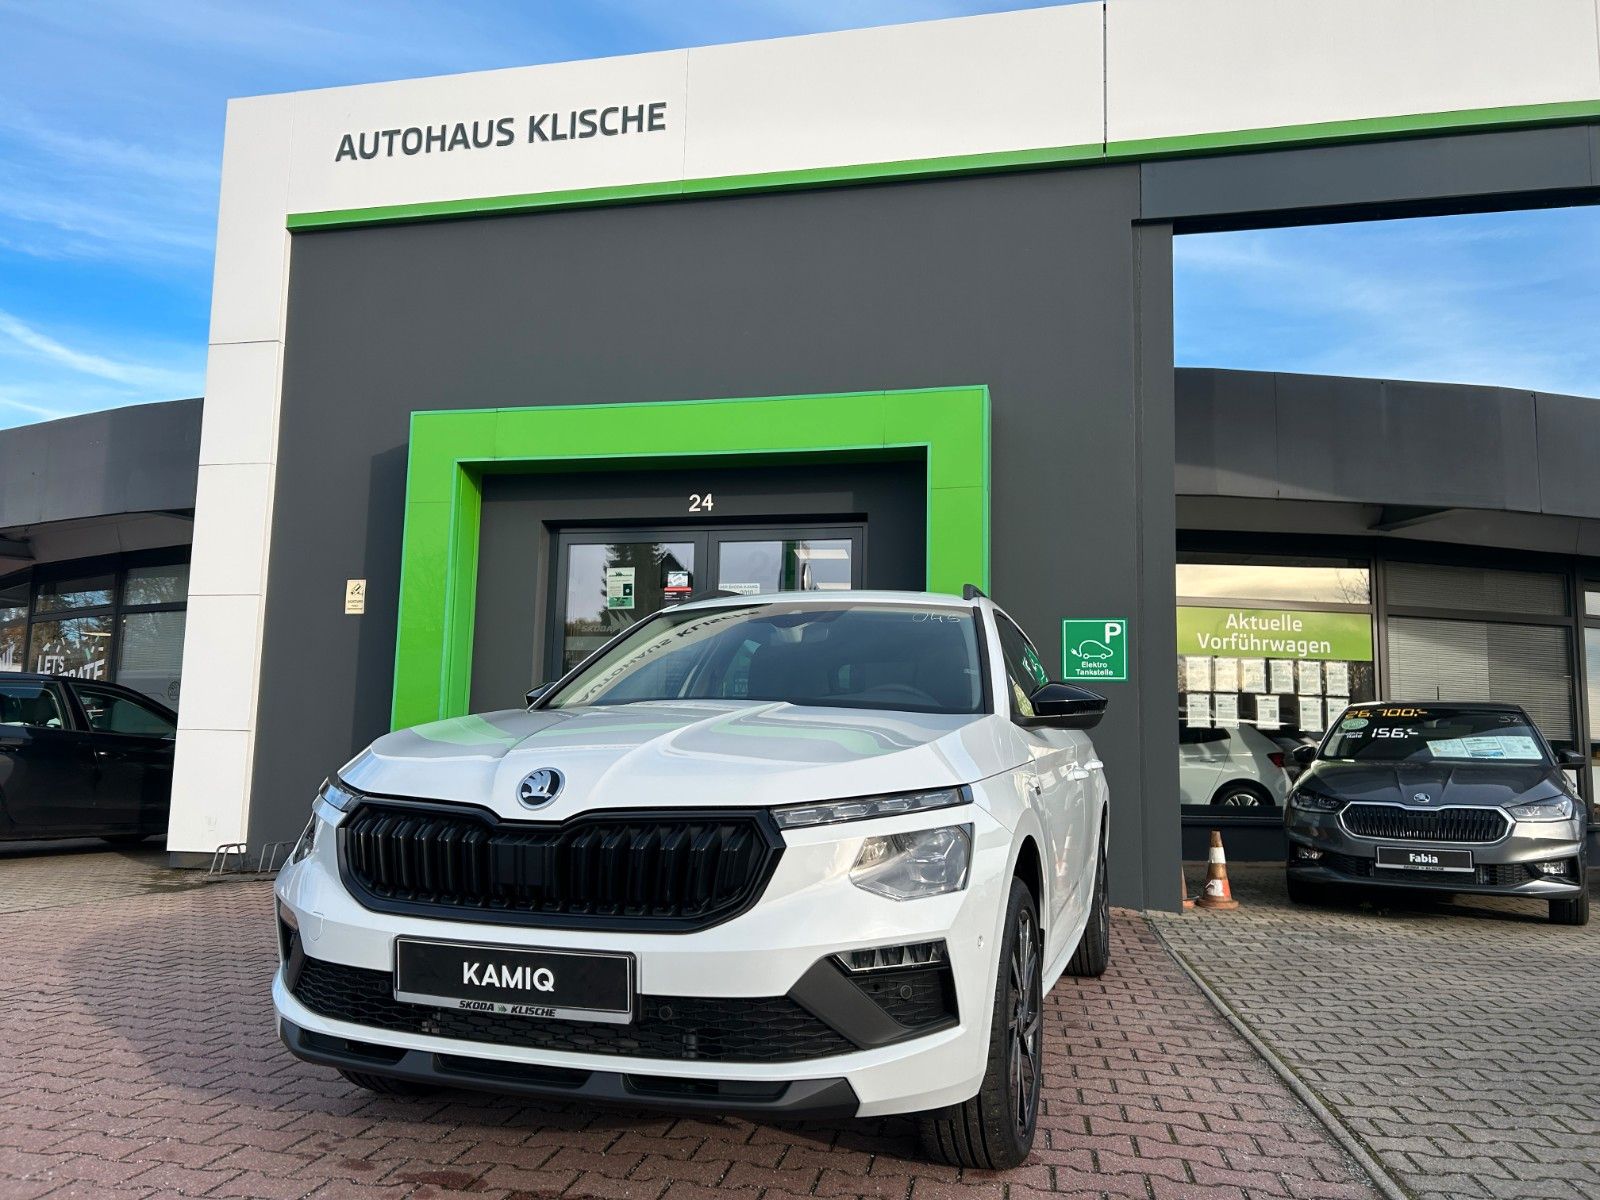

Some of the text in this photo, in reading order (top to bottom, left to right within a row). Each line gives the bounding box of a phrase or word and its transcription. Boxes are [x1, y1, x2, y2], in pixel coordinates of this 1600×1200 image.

[335, 102, 667, 162] AUTOHAUS KLISCHE
[688, 494, 713, 512] 24
[1226, 613, 1303, 632] Aktuelle
[1104, 622, 1122, 644] P
[1197, 632, 1331, 657] Vorführwagen
[37, 654, 65, 674] LET'S
[1409, 853, 1438, 864] Fabia
[462, 961, 555, 993] KAMIQ
[458, 1000, 556, 1018] SKODA KLISCHE
